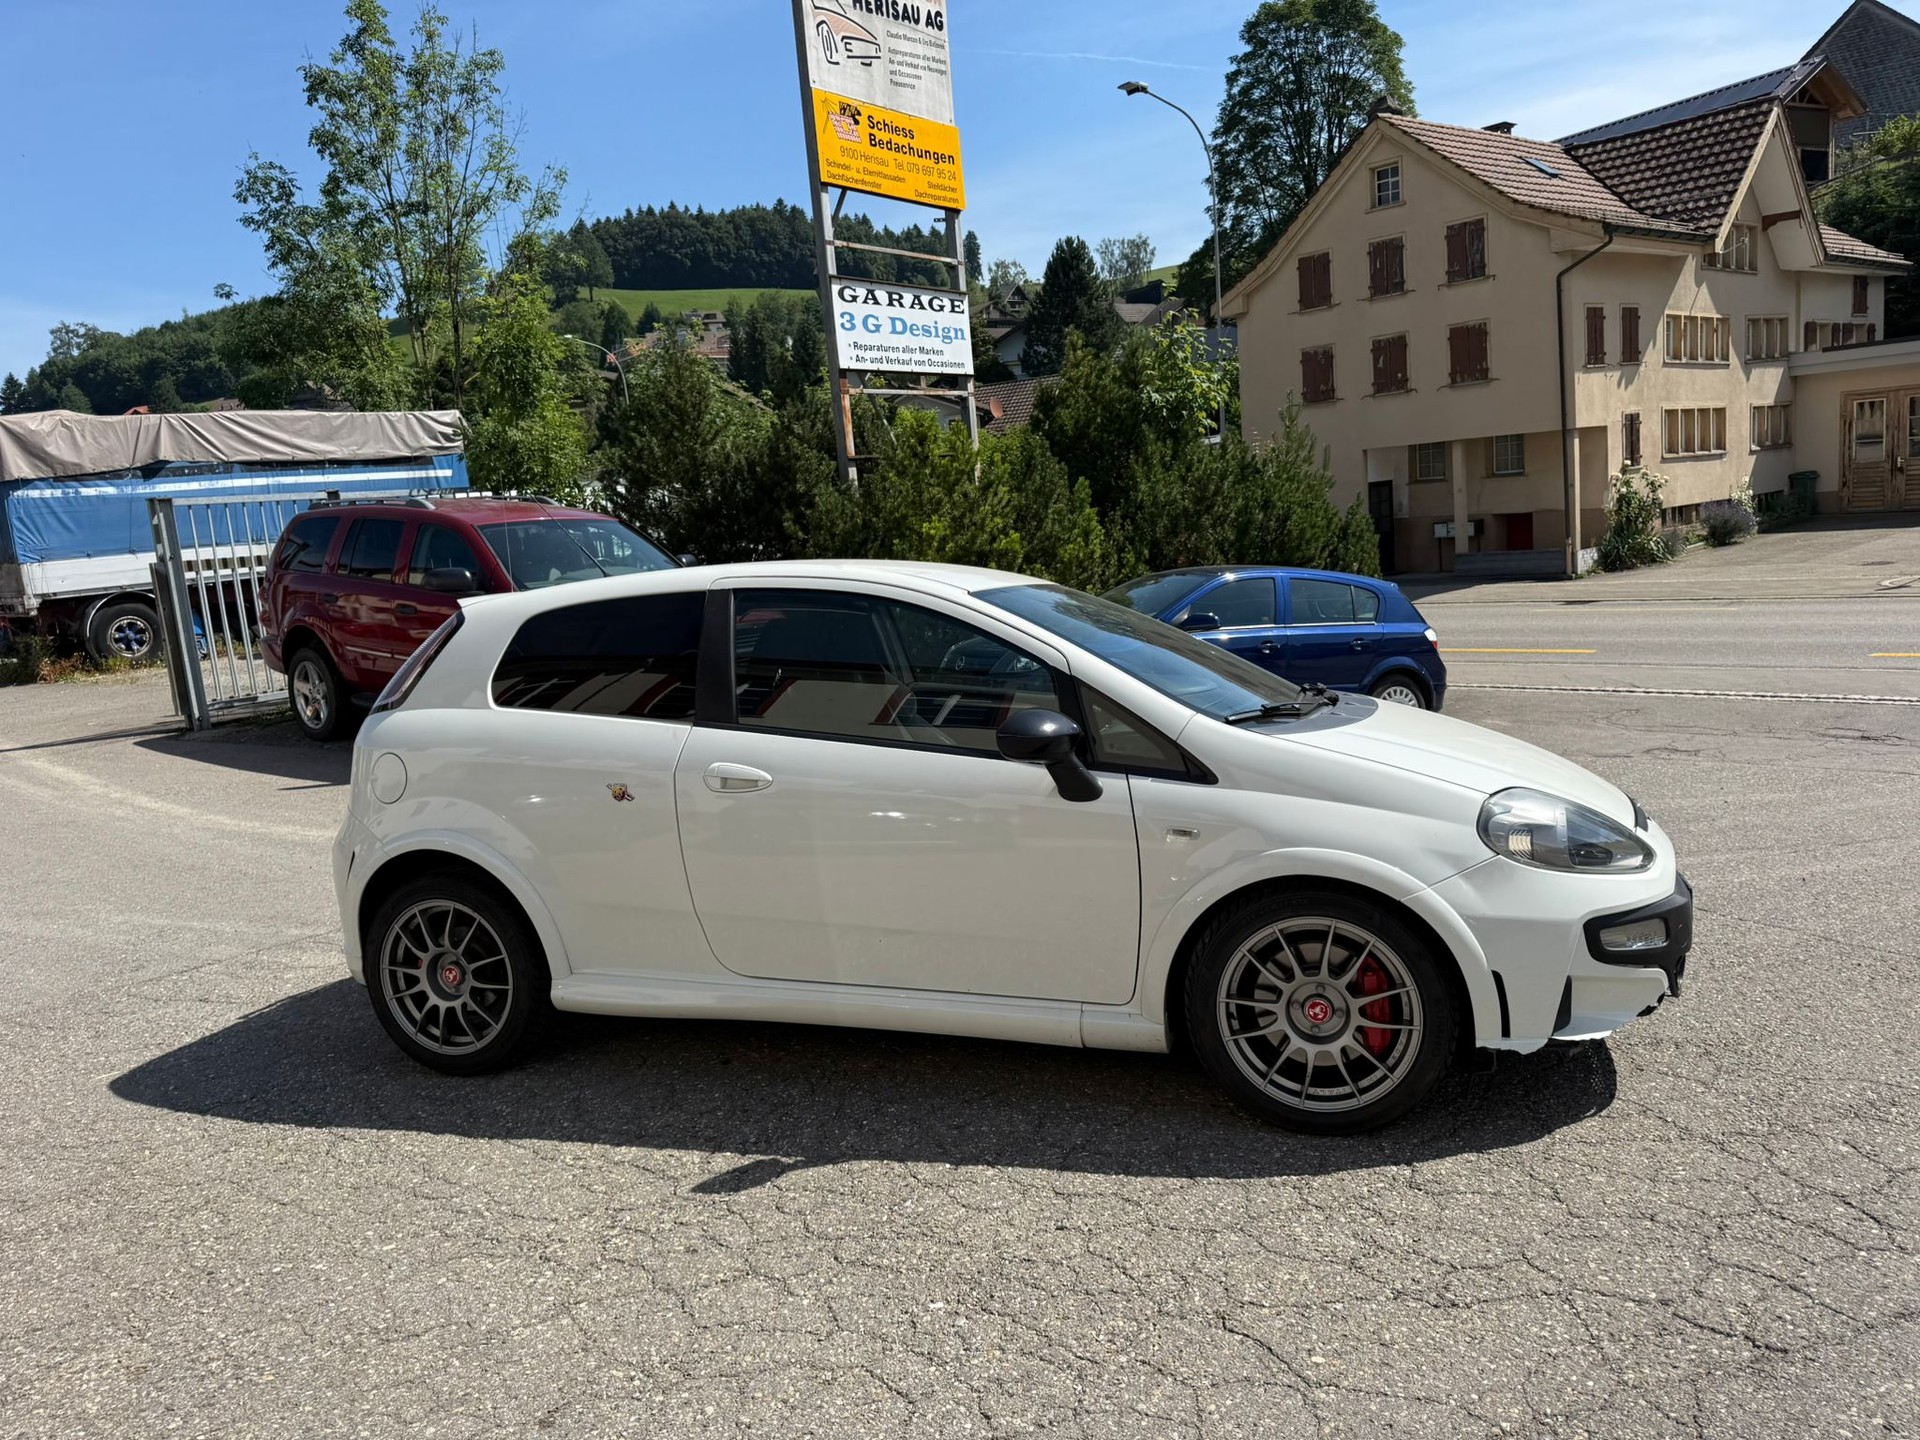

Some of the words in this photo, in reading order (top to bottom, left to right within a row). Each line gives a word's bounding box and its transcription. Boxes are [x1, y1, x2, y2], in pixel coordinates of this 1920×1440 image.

[925, 9, 944, 32] AG
[896, 59, 904, 67] und
[904, 60, 920, 70] Verkauf
[922, 53, 931, 62] aller
[931, 55, 947, 66] Marken
[890, 78, 916, 90] Pneuservice
[898, 70, 922, 81] Occasionen
[868, 115, 915, 140] Schiess
[868, 132, 955, 165] Bedachungen
[825, 158, 854, 172] Schindel-
[862, 167, 906, 184] Eternitfassaden
[840, 146, 859, 161] 9100
[860, 150, 889, 167] Herisau
[922, 165, 935, 178] 697
[936, 169, 947, 180] 95
[948, 170, 957, 182] 24
[914, 189, 960, 205] Dachreparaturen
[837, 285, 965, 315] GARAGE
[888, 316, 967, 345] Design
[853, 342, 900, 354] Reparaturen
[901, 342, 918, 355] aller
[918, 346, 944, 356] Marken
[855, 354, 868, 364] An-
[870, 354, 884, 365] und
[885, 356, 913, 367] Verkauf
[914, 359, 926, 367] von
[927, 359, 966, 370] Occasionen
